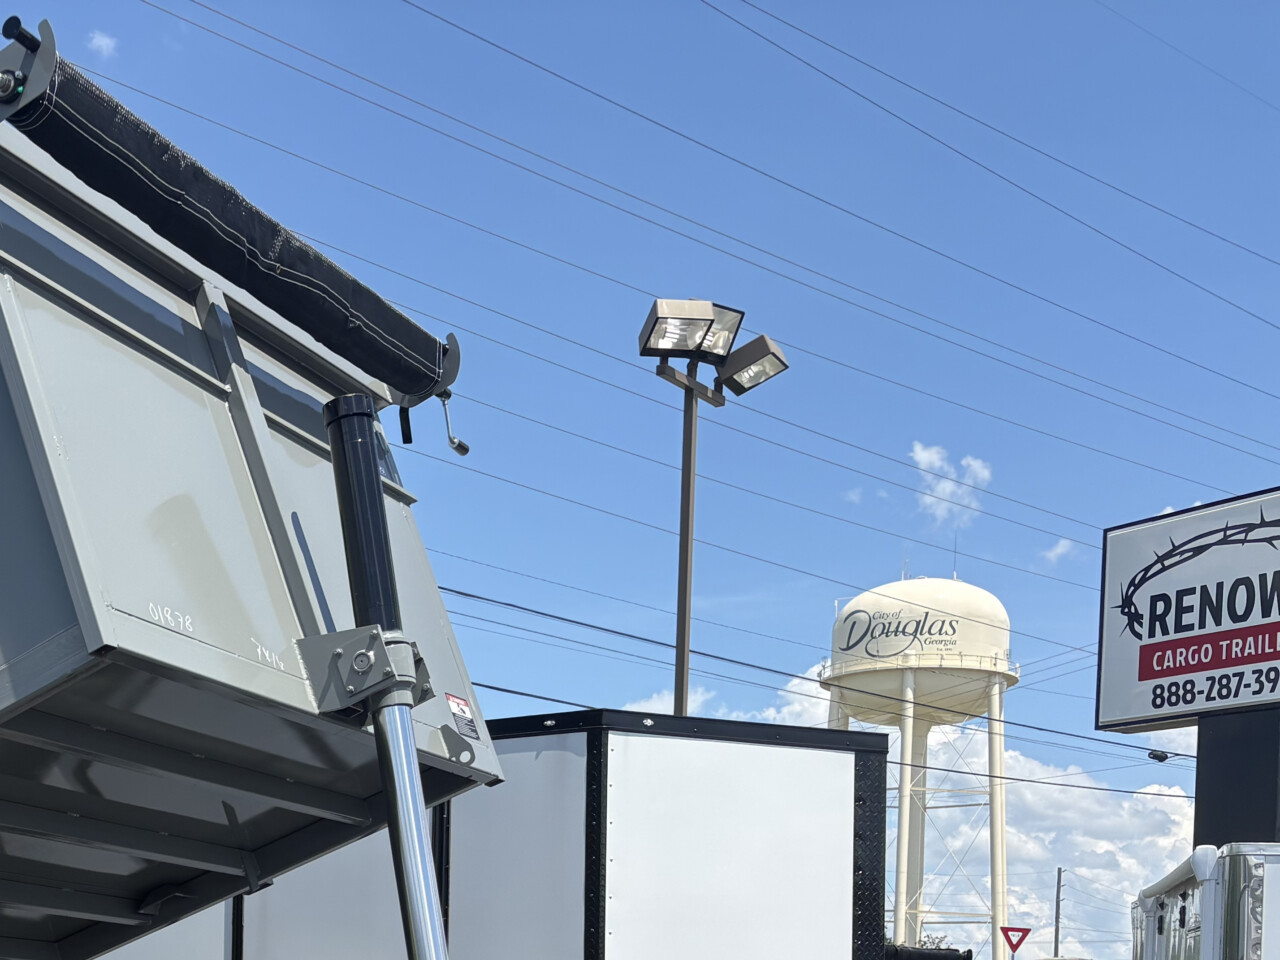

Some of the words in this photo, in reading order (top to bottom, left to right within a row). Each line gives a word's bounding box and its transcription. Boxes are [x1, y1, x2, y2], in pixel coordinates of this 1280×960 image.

[148, 602, 193, 632] 01878
[872, 611, 891, 621] City
[891, 608, 903, 620] of
[838, 609, 959, 658] Douglas
[923, 637, 958, 647] Georgia
[1152, 643, 1213, 671] CARGO
[1151, 666, 1280, 709] 888-287-39
